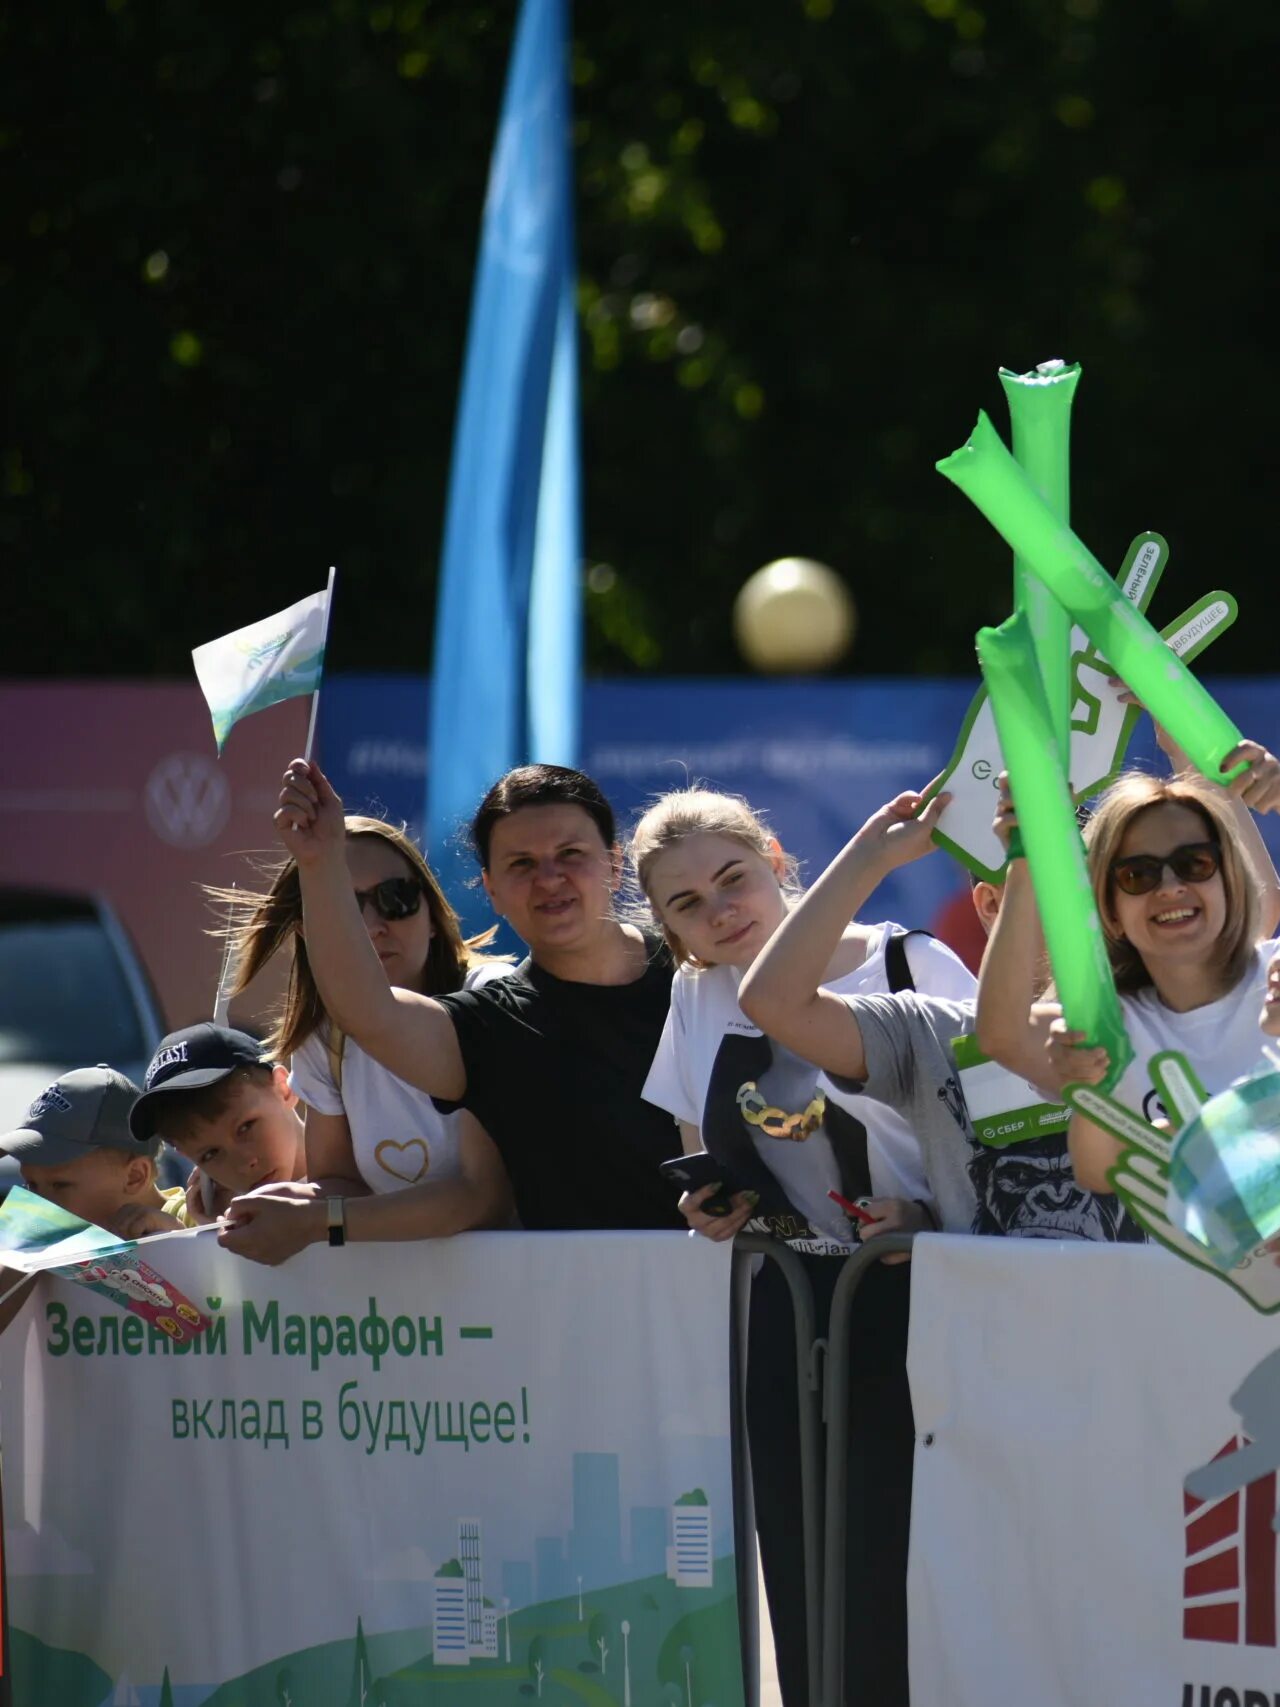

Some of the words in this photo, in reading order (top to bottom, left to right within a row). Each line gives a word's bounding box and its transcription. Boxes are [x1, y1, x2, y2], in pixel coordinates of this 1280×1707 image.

[145, 1040, 189, 1092] LAST
[997, 1121, 1025, 1135] СБЕР
[242, 1297, 445, 1372] Марафон
[172, 1397, 290, 1449] вклад
[302, 1399, 324, 1440] в
[338, 1380, 531, 1456] будущее!
